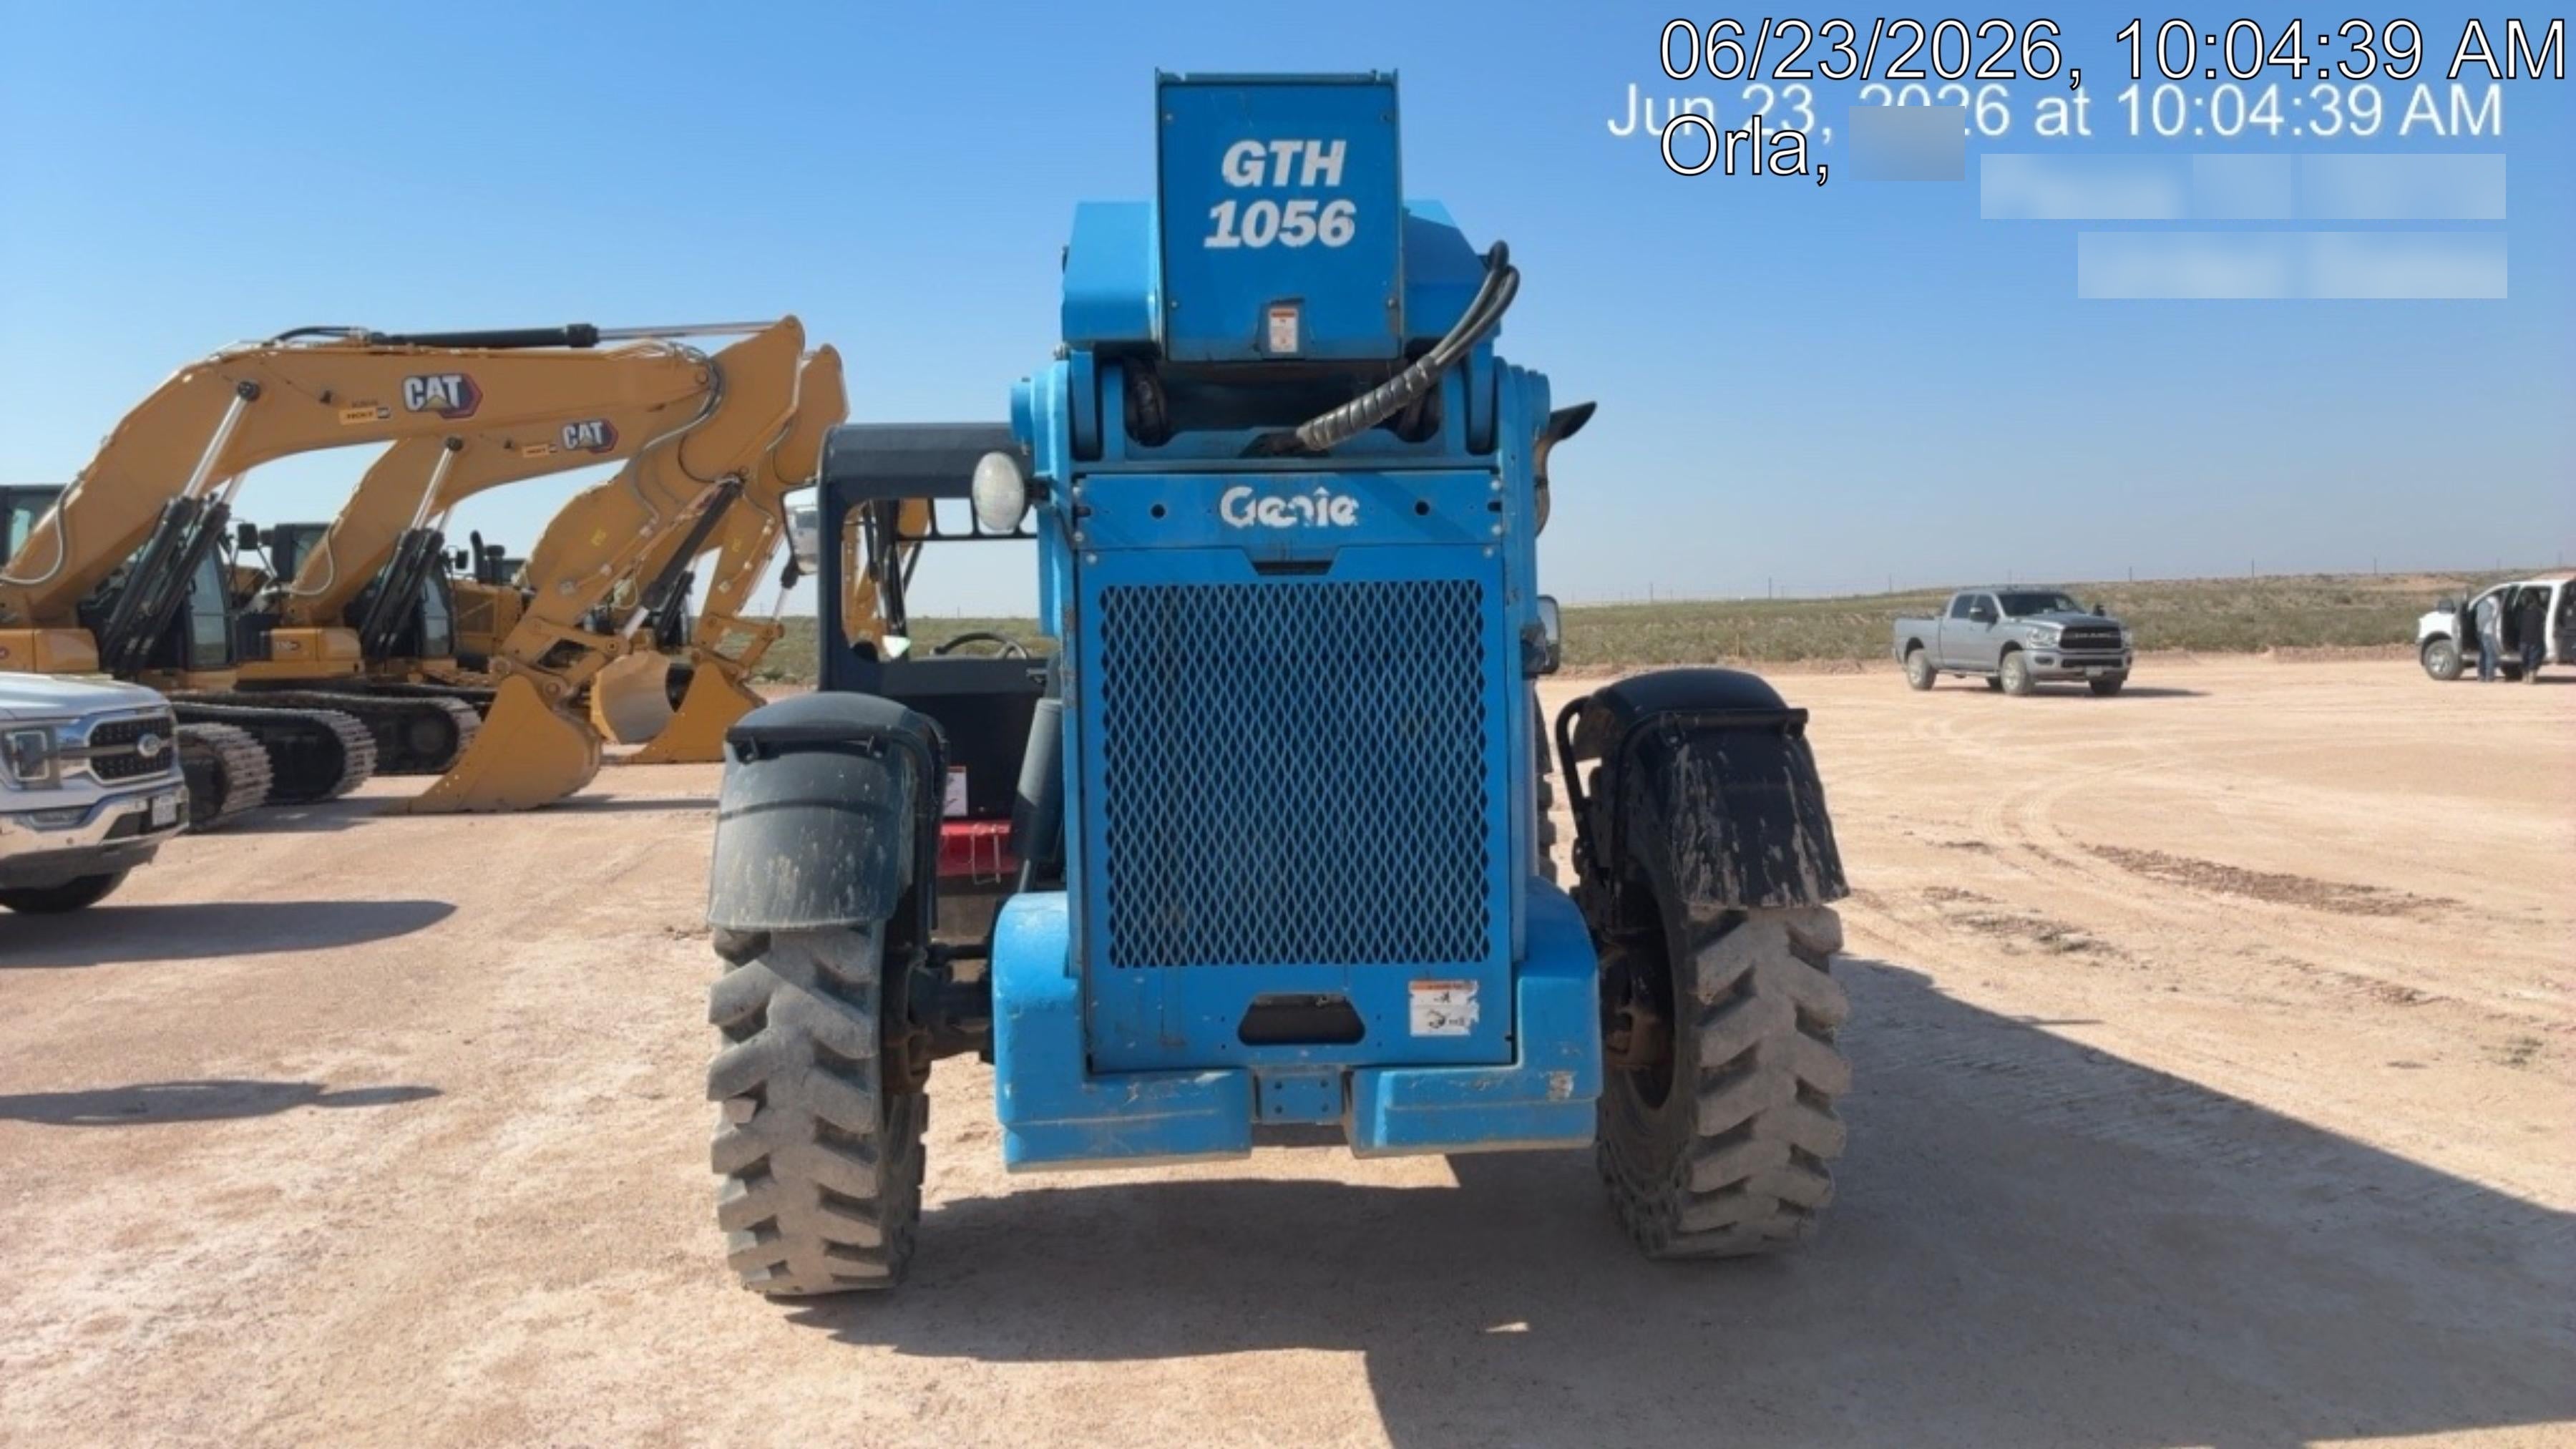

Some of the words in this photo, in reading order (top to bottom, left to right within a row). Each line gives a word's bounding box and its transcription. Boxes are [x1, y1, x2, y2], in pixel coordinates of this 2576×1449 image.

[1221, 140, 1347, 187] GTH
[1204, 200, 1357, 248] 1056
[404, 374, 462, 411] CAT
[562, 421, 602, 449] CAT
[1221, 487, 1358, 528] Genie
